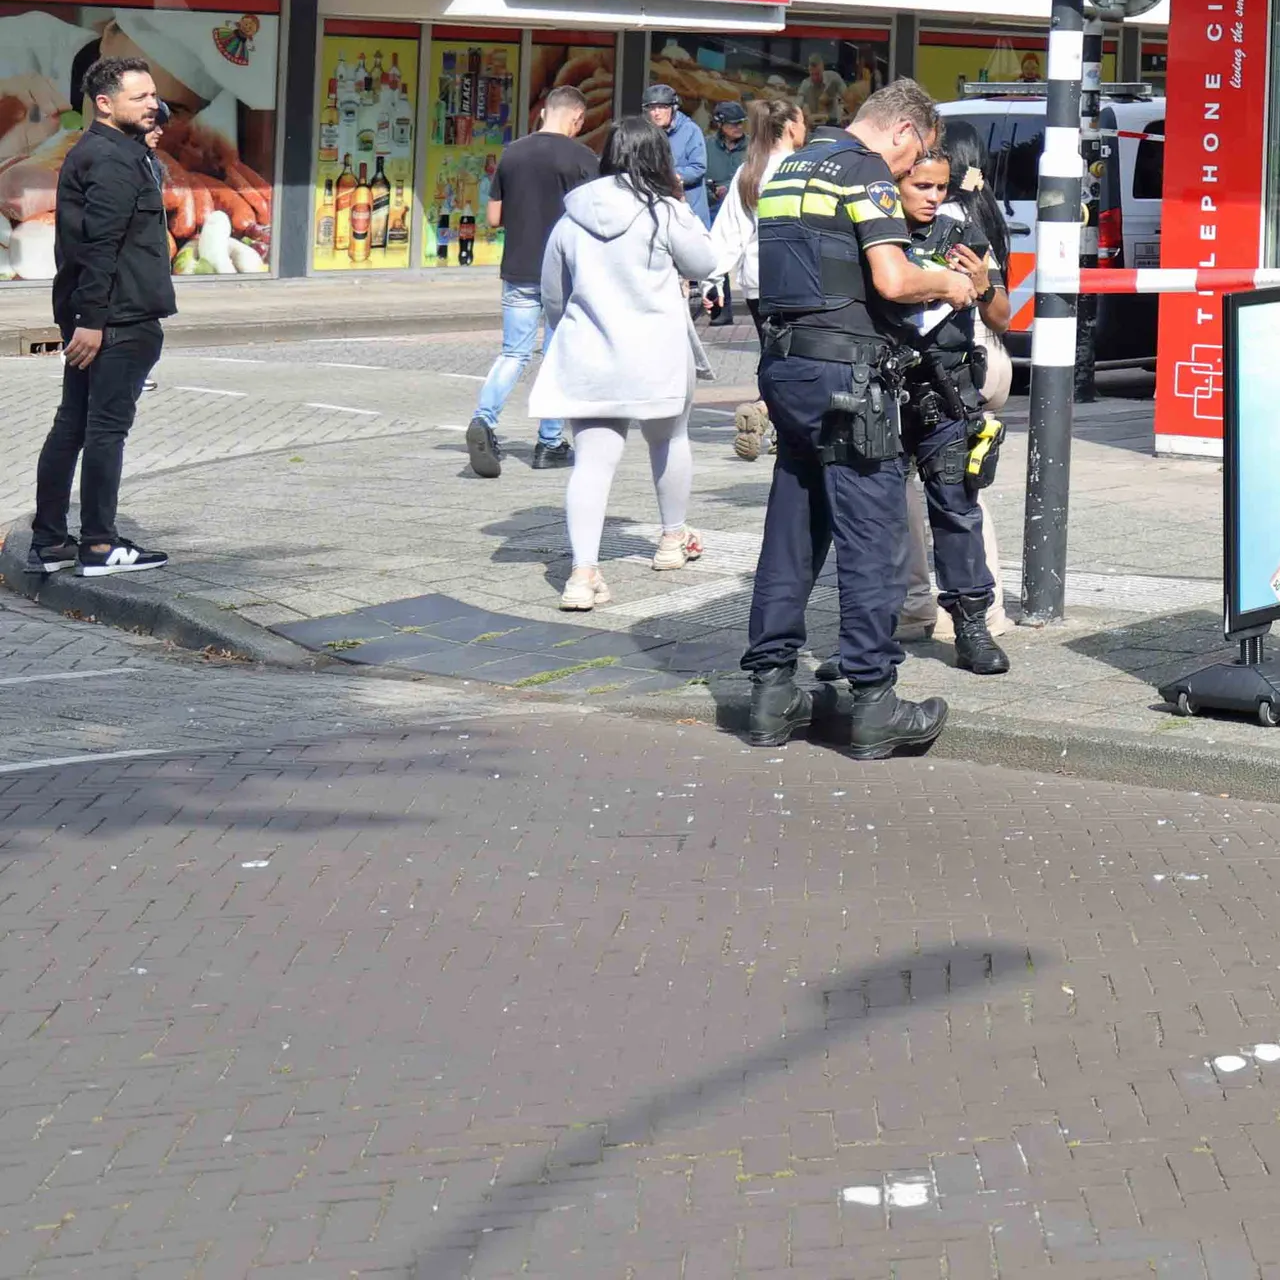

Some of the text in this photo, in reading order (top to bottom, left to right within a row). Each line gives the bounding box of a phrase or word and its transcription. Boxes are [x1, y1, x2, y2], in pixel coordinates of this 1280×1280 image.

[1230, 22, 1244, 43] the
[1229, 48, 1246, 89] living
[777, 160, 806, 174] ITIE
[1197, 74, 1222, 324] TLEPHONE
